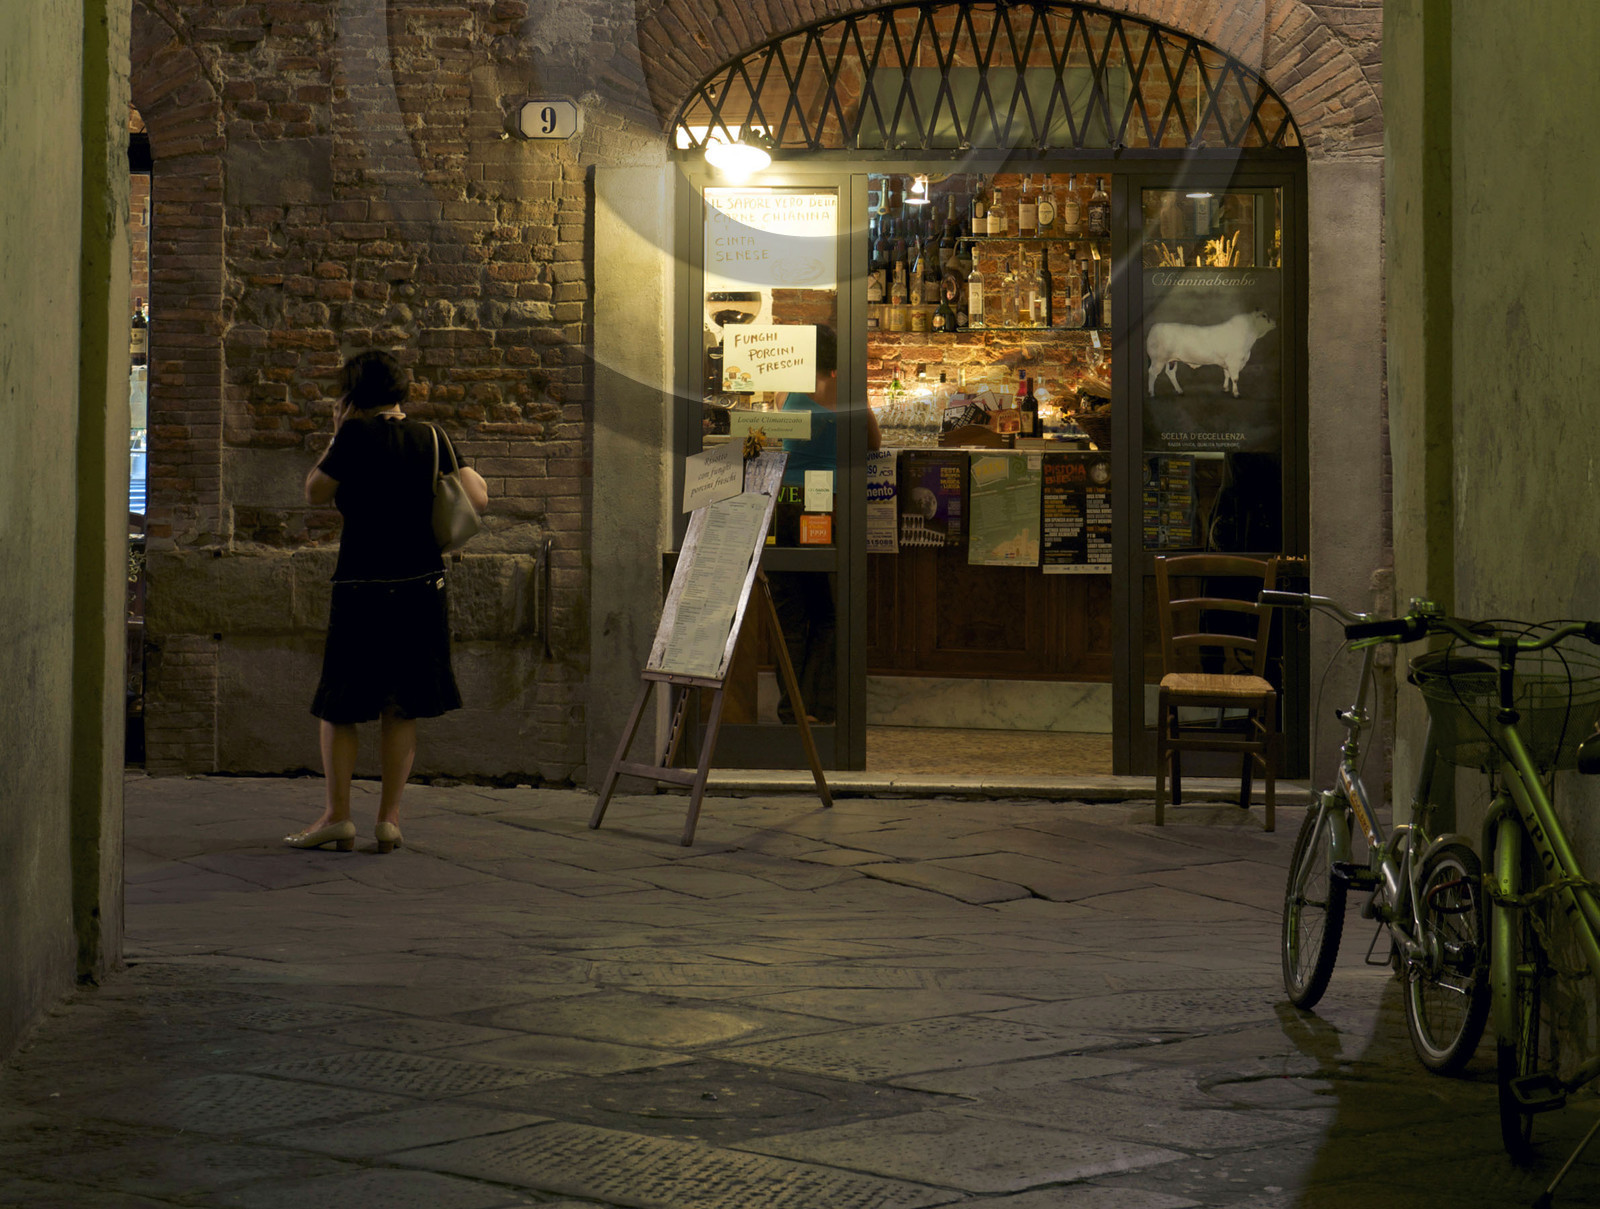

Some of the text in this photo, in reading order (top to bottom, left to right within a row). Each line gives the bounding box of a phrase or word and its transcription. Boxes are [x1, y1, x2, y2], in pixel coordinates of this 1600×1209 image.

[541, 107, 557, 135] 9
[714, 236, 756, 247] CINTA
[715, 249, 770, 263] SENESE
[734, 332, 778, 348] FUNGHI
[748, 345, 795, 361] PORCINI
[756, 358, 804, 375] FRESCHI
[1161, 432, 1188, 441] SCELTA
